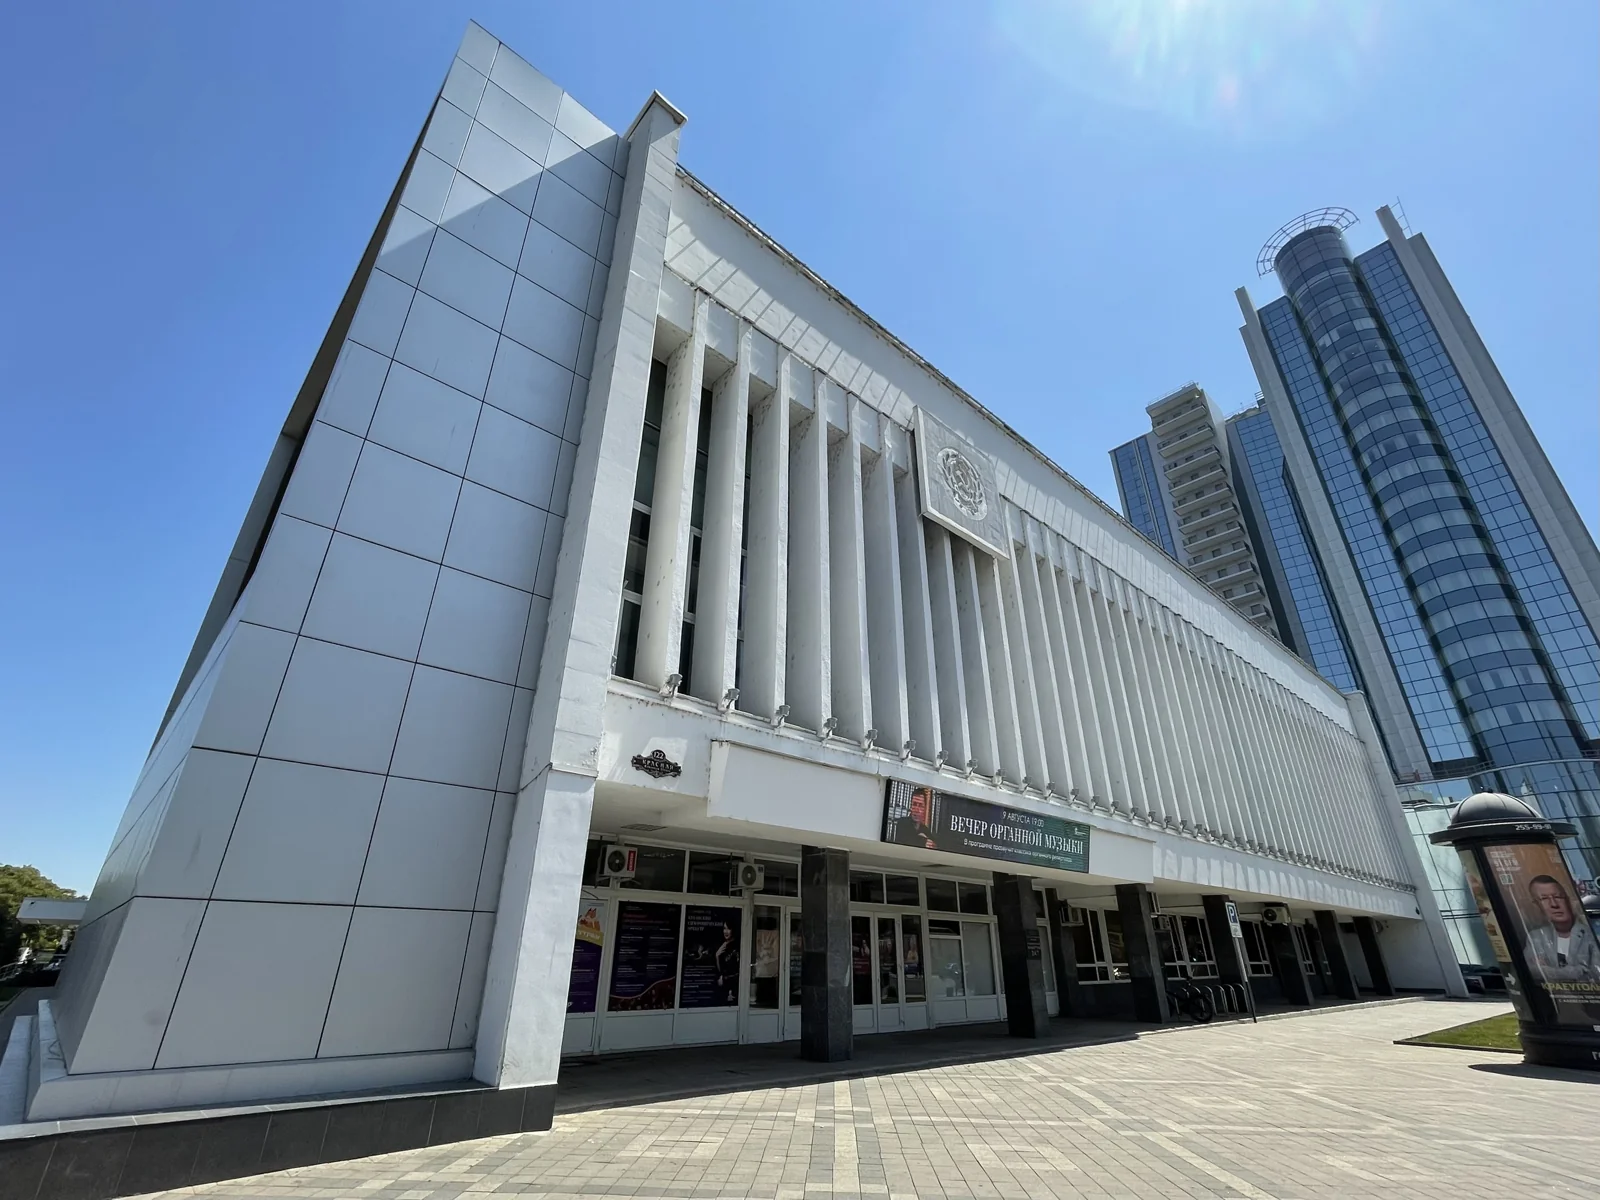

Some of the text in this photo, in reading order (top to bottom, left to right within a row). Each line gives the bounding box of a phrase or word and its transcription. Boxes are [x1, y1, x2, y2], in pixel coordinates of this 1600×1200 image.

[653, 751, 664, 760] 122
[1002, 811, 1007, 820] 9
[1007, 812, 1030, 825] АВГУСТА
[951, 815, 1083, 854] ВЕЧЕР ОРГАННОЙ МУЗЫКИ
